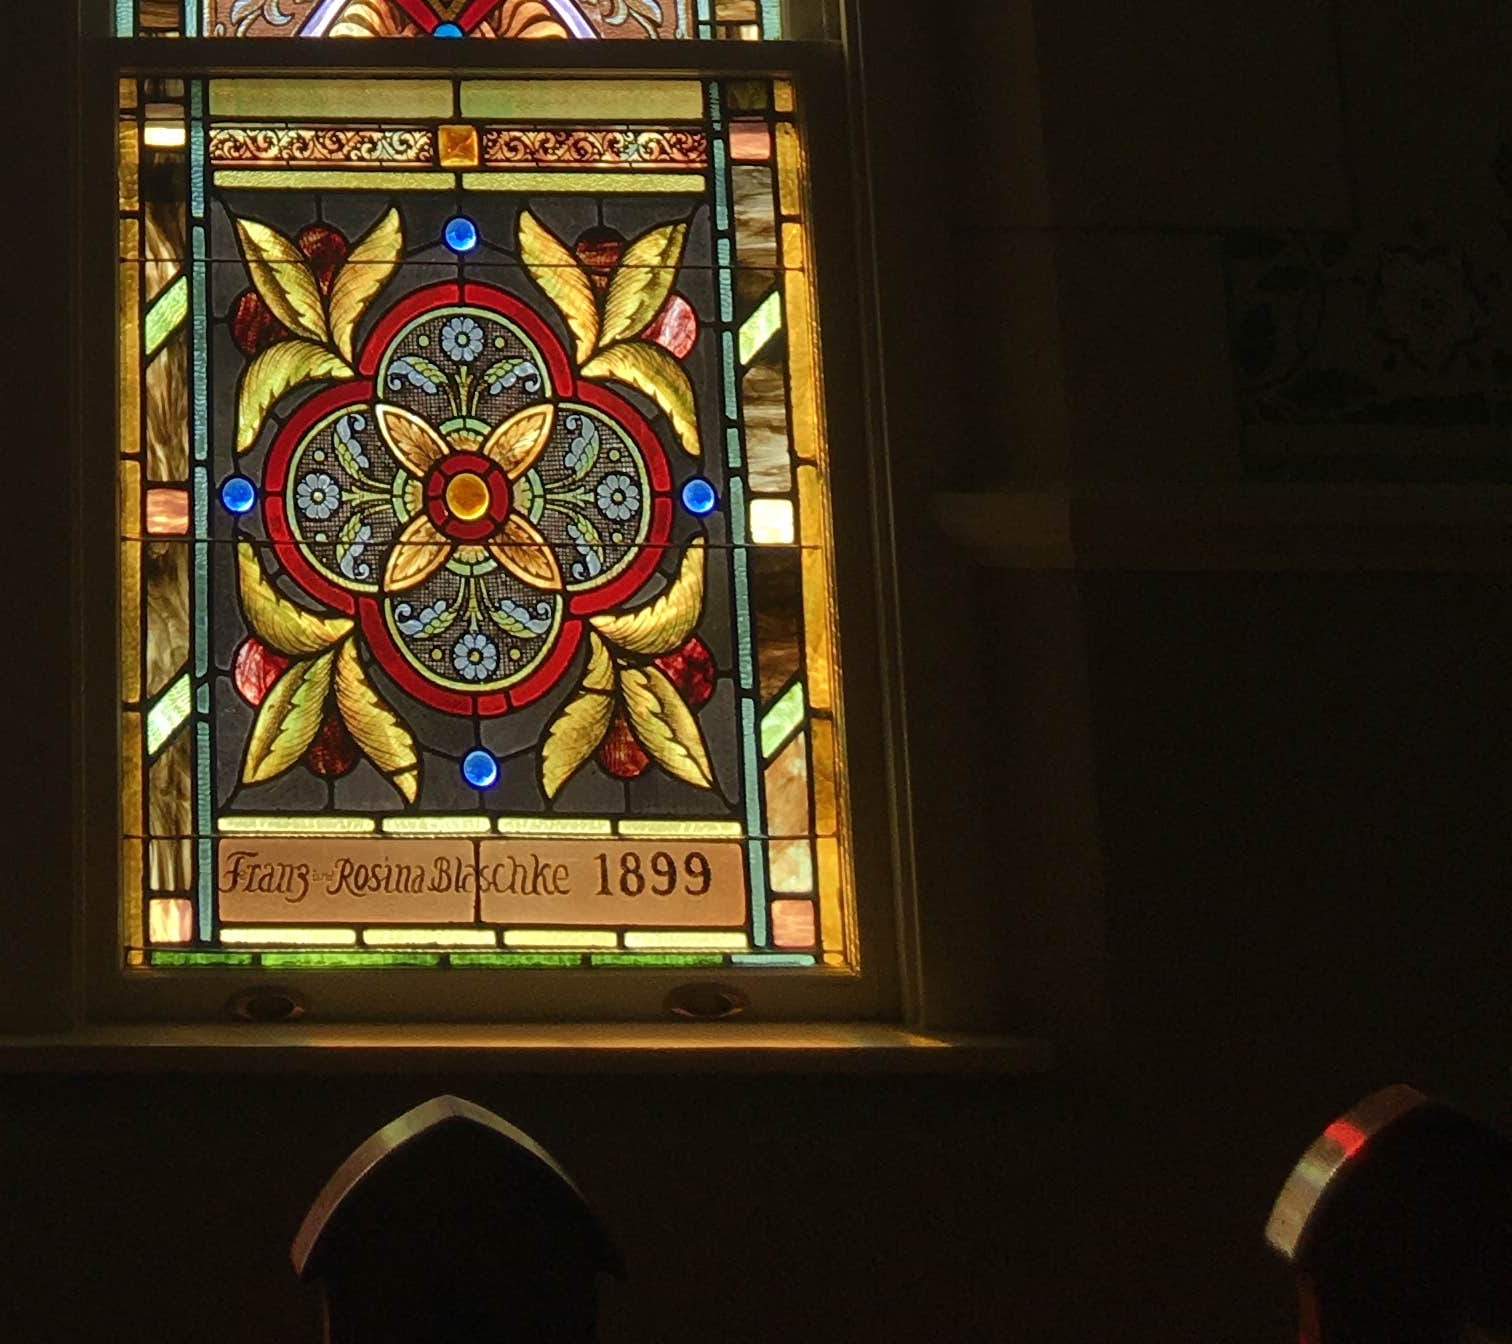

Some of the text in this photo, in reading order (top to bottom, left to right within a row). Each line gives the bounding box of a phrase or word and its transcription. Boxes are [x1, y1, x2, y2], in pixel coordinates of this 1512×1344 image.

[219, 851, 310, 903] Franz
[327, 857, 425, 897] Rosina
[594, 851, 711, 897] 1899
